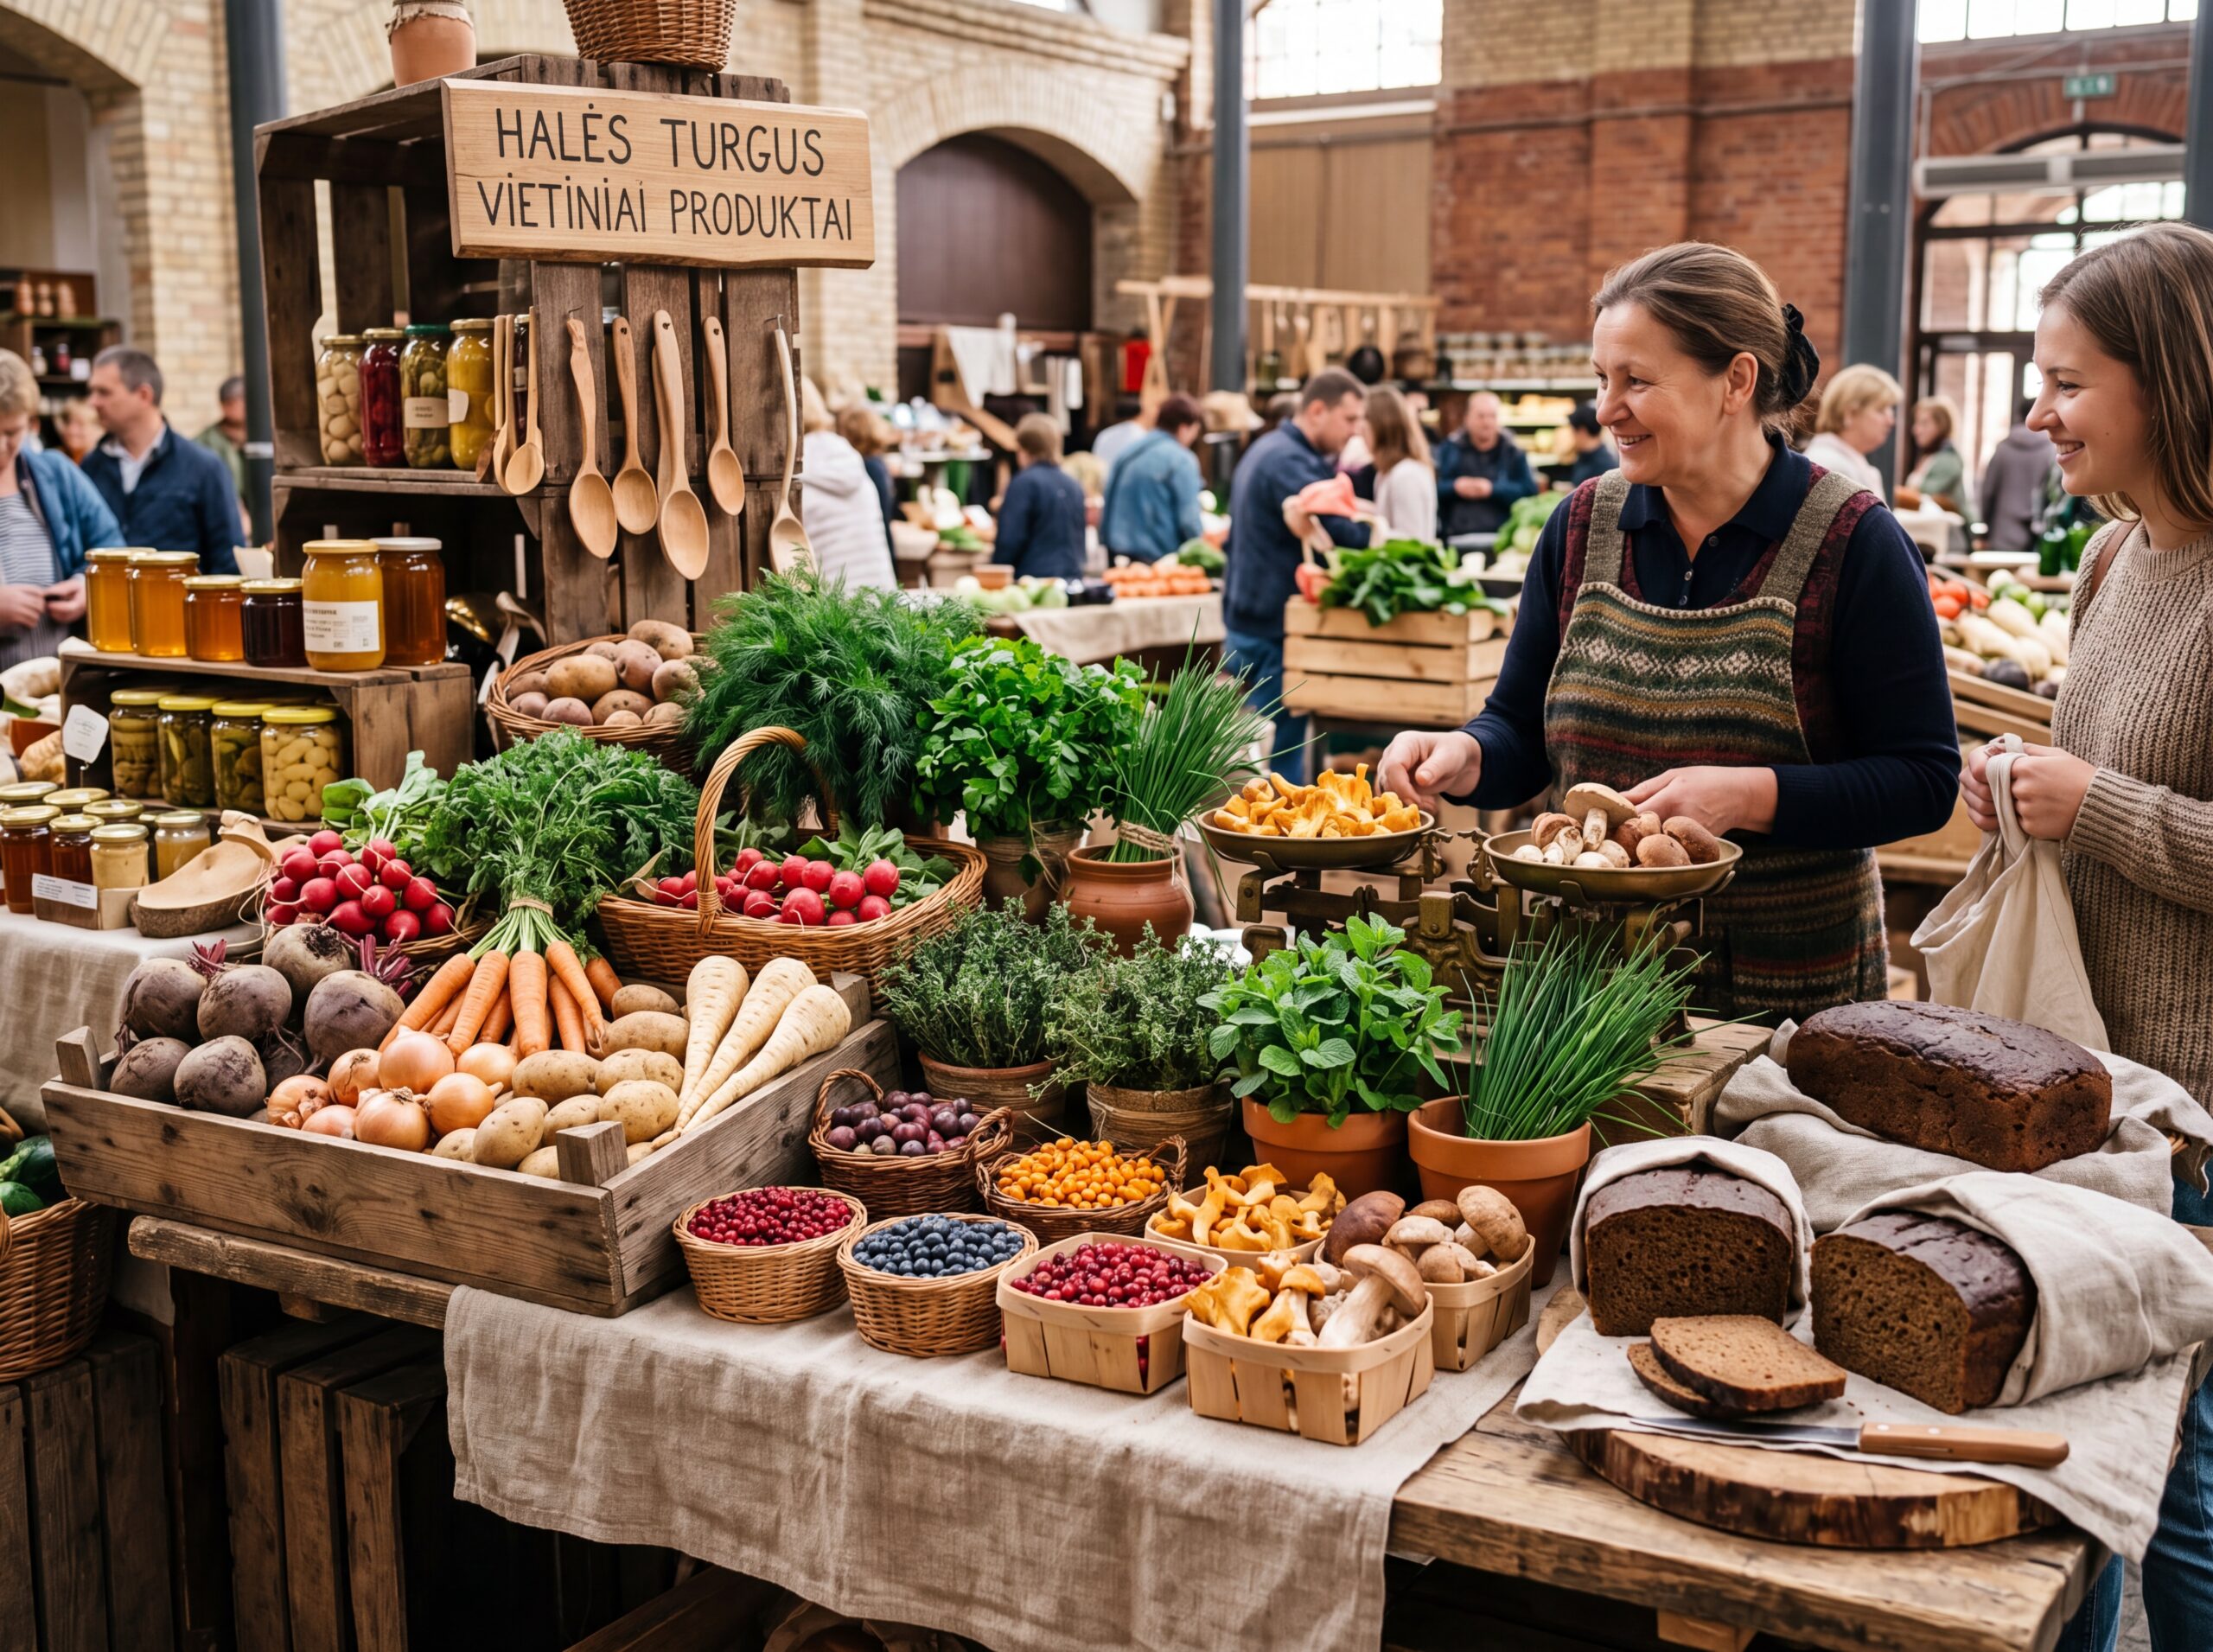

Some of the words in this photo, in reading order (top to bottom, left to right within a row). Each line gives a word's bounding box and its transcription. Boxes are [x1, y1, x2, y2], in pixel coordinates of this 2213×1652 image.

[495, 103, 632, 165] HALĖS
[660, 118, 824, 176] TURGUS
[670, 188, 852, 240] PRODUKTAI
